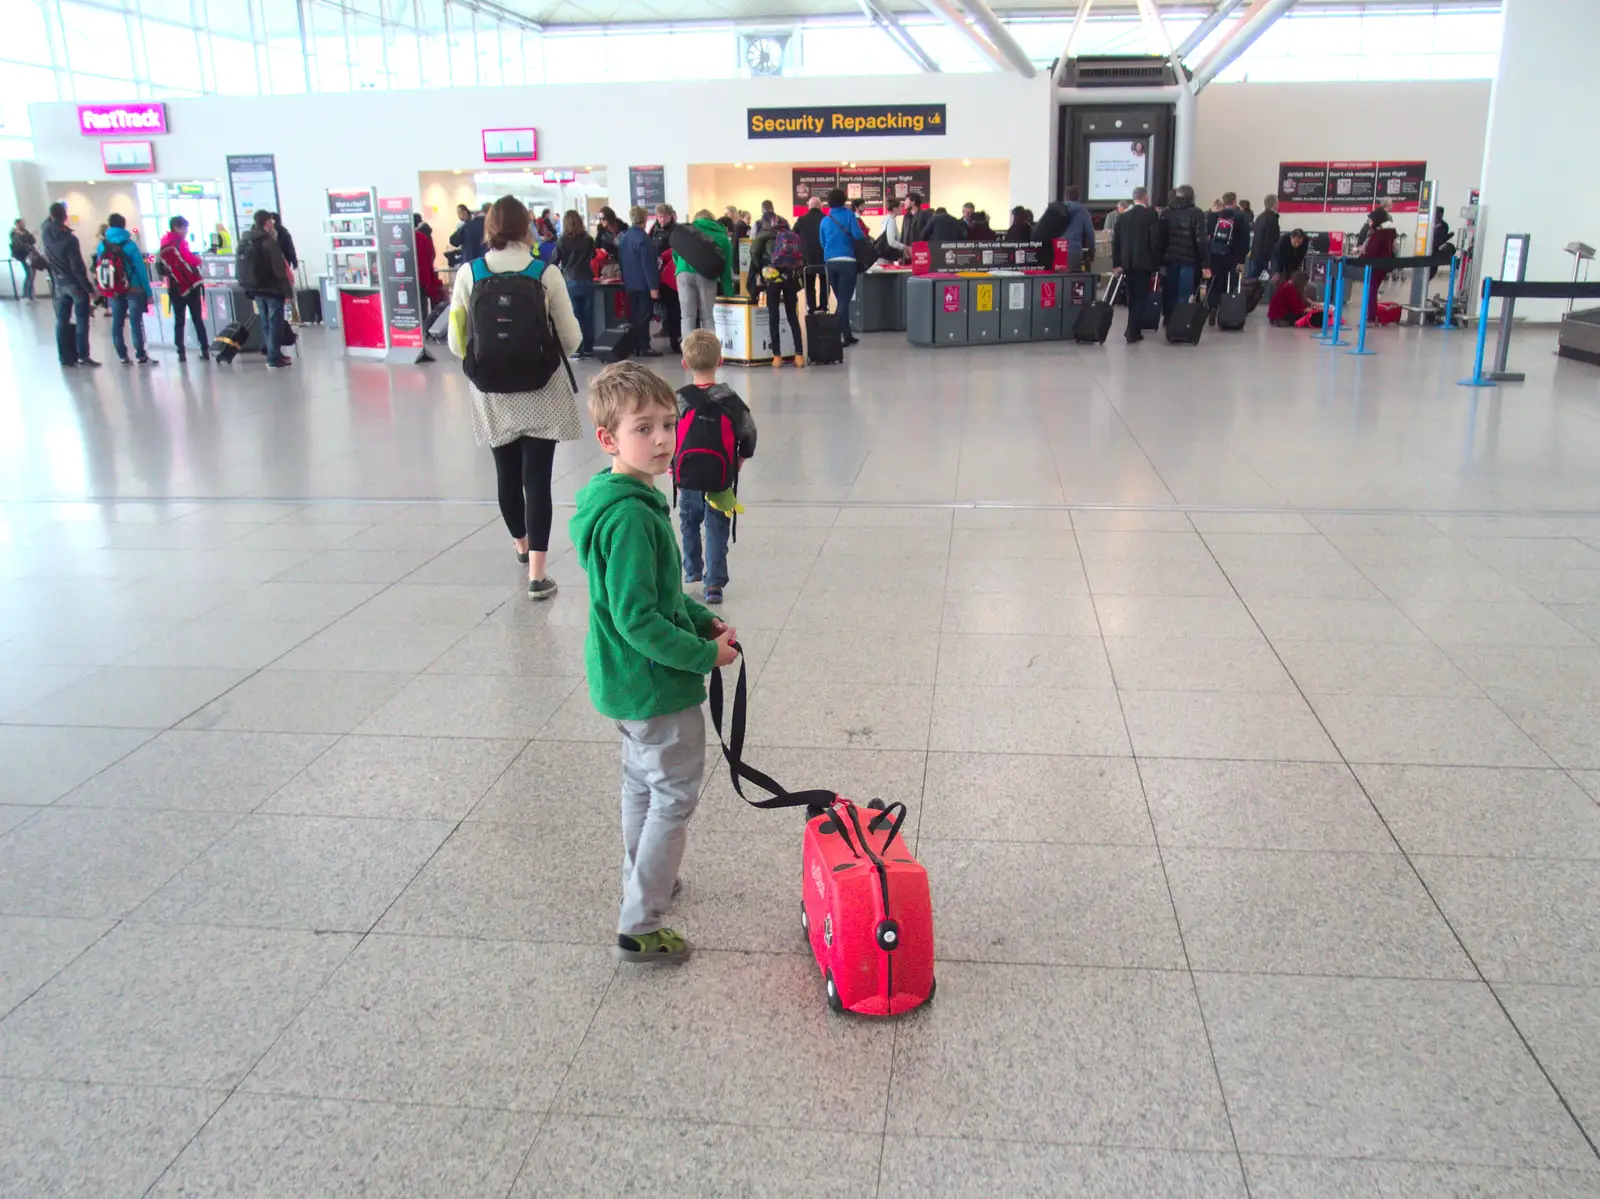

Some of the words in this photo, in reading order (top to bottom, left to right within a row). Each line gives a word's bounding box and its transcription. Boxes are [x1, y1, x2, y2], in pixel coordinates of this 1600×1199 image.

[82, 108, 161, 129] FastTrack
[751, 114, 824, 133] Security
[831, 112, 924, 132] Repacking
